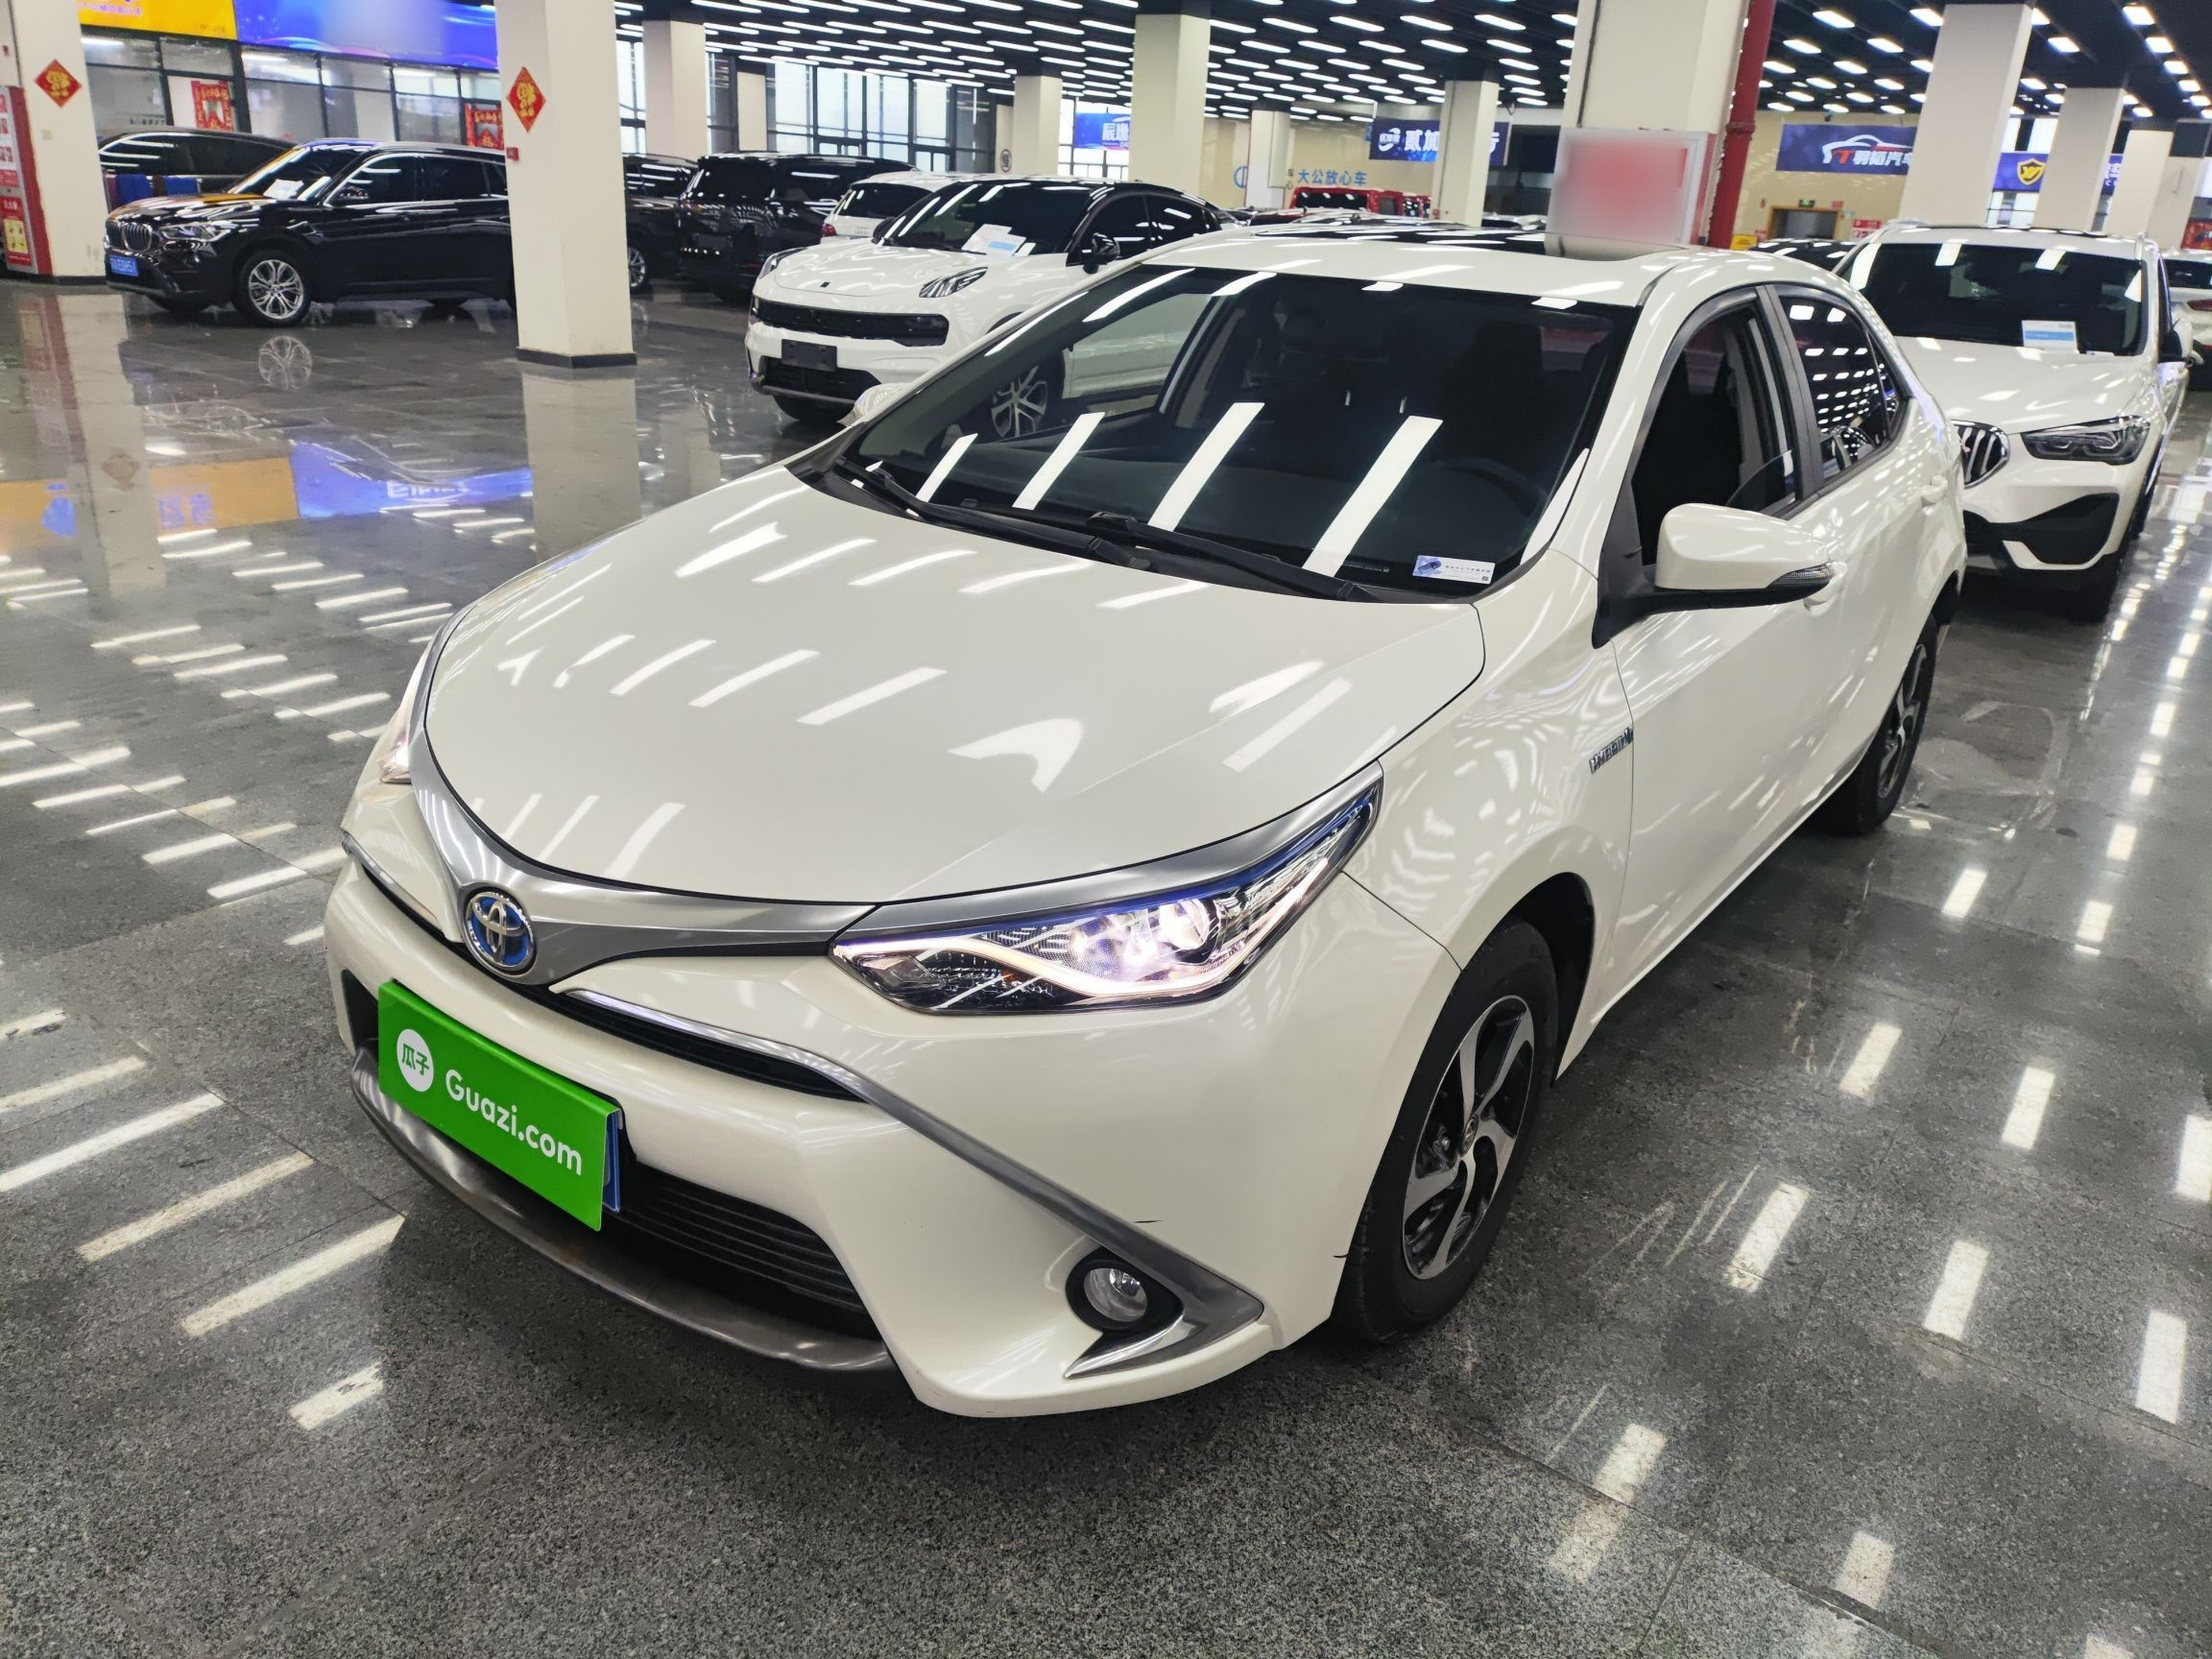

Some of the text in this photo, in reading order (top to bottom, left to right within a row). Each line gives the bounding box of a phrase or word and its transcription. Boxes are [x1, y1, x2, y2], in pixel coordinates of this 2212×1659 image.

[1297, 169, 1367, 187] 大公放心车
[402, 1043, 430, 1076] 瓜子
[445, 1069, 582, 1176] Guazi.com
